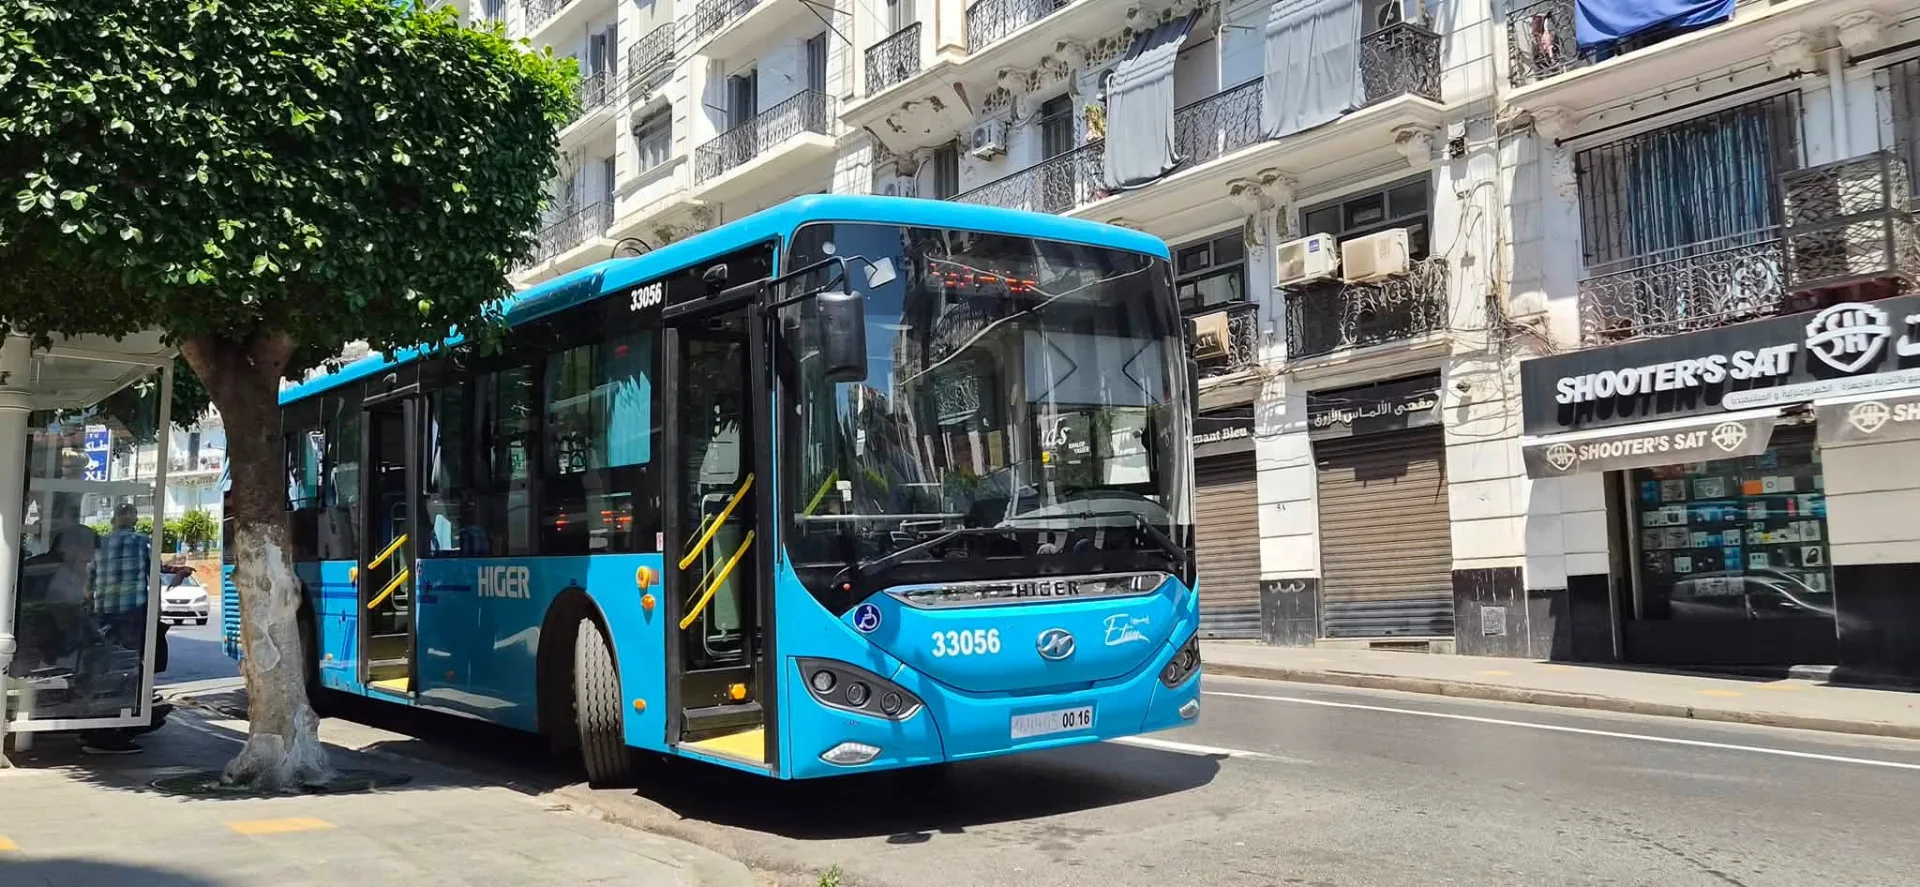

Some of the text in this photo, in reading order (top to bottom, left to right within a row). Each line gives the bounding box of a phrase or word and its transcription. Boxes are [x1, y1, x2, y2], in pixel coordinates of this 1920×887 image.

[630, 281, 662, 312] 33056
[1555, 343, 1798, 405] SHOOTER'S SAT
[1193, 426, 1248, 444] mant Bleu
[1579, 431, 1708, 461] SHOOTER'S SAT
[478, 566, 531, 599] HIGER
[1016, 581, 1079, 597] HIGER
[931, 628, 1000, 657] 33056
[1062, 712, 1075, 728] 00
[1078, 709, 1090, 726] 16
